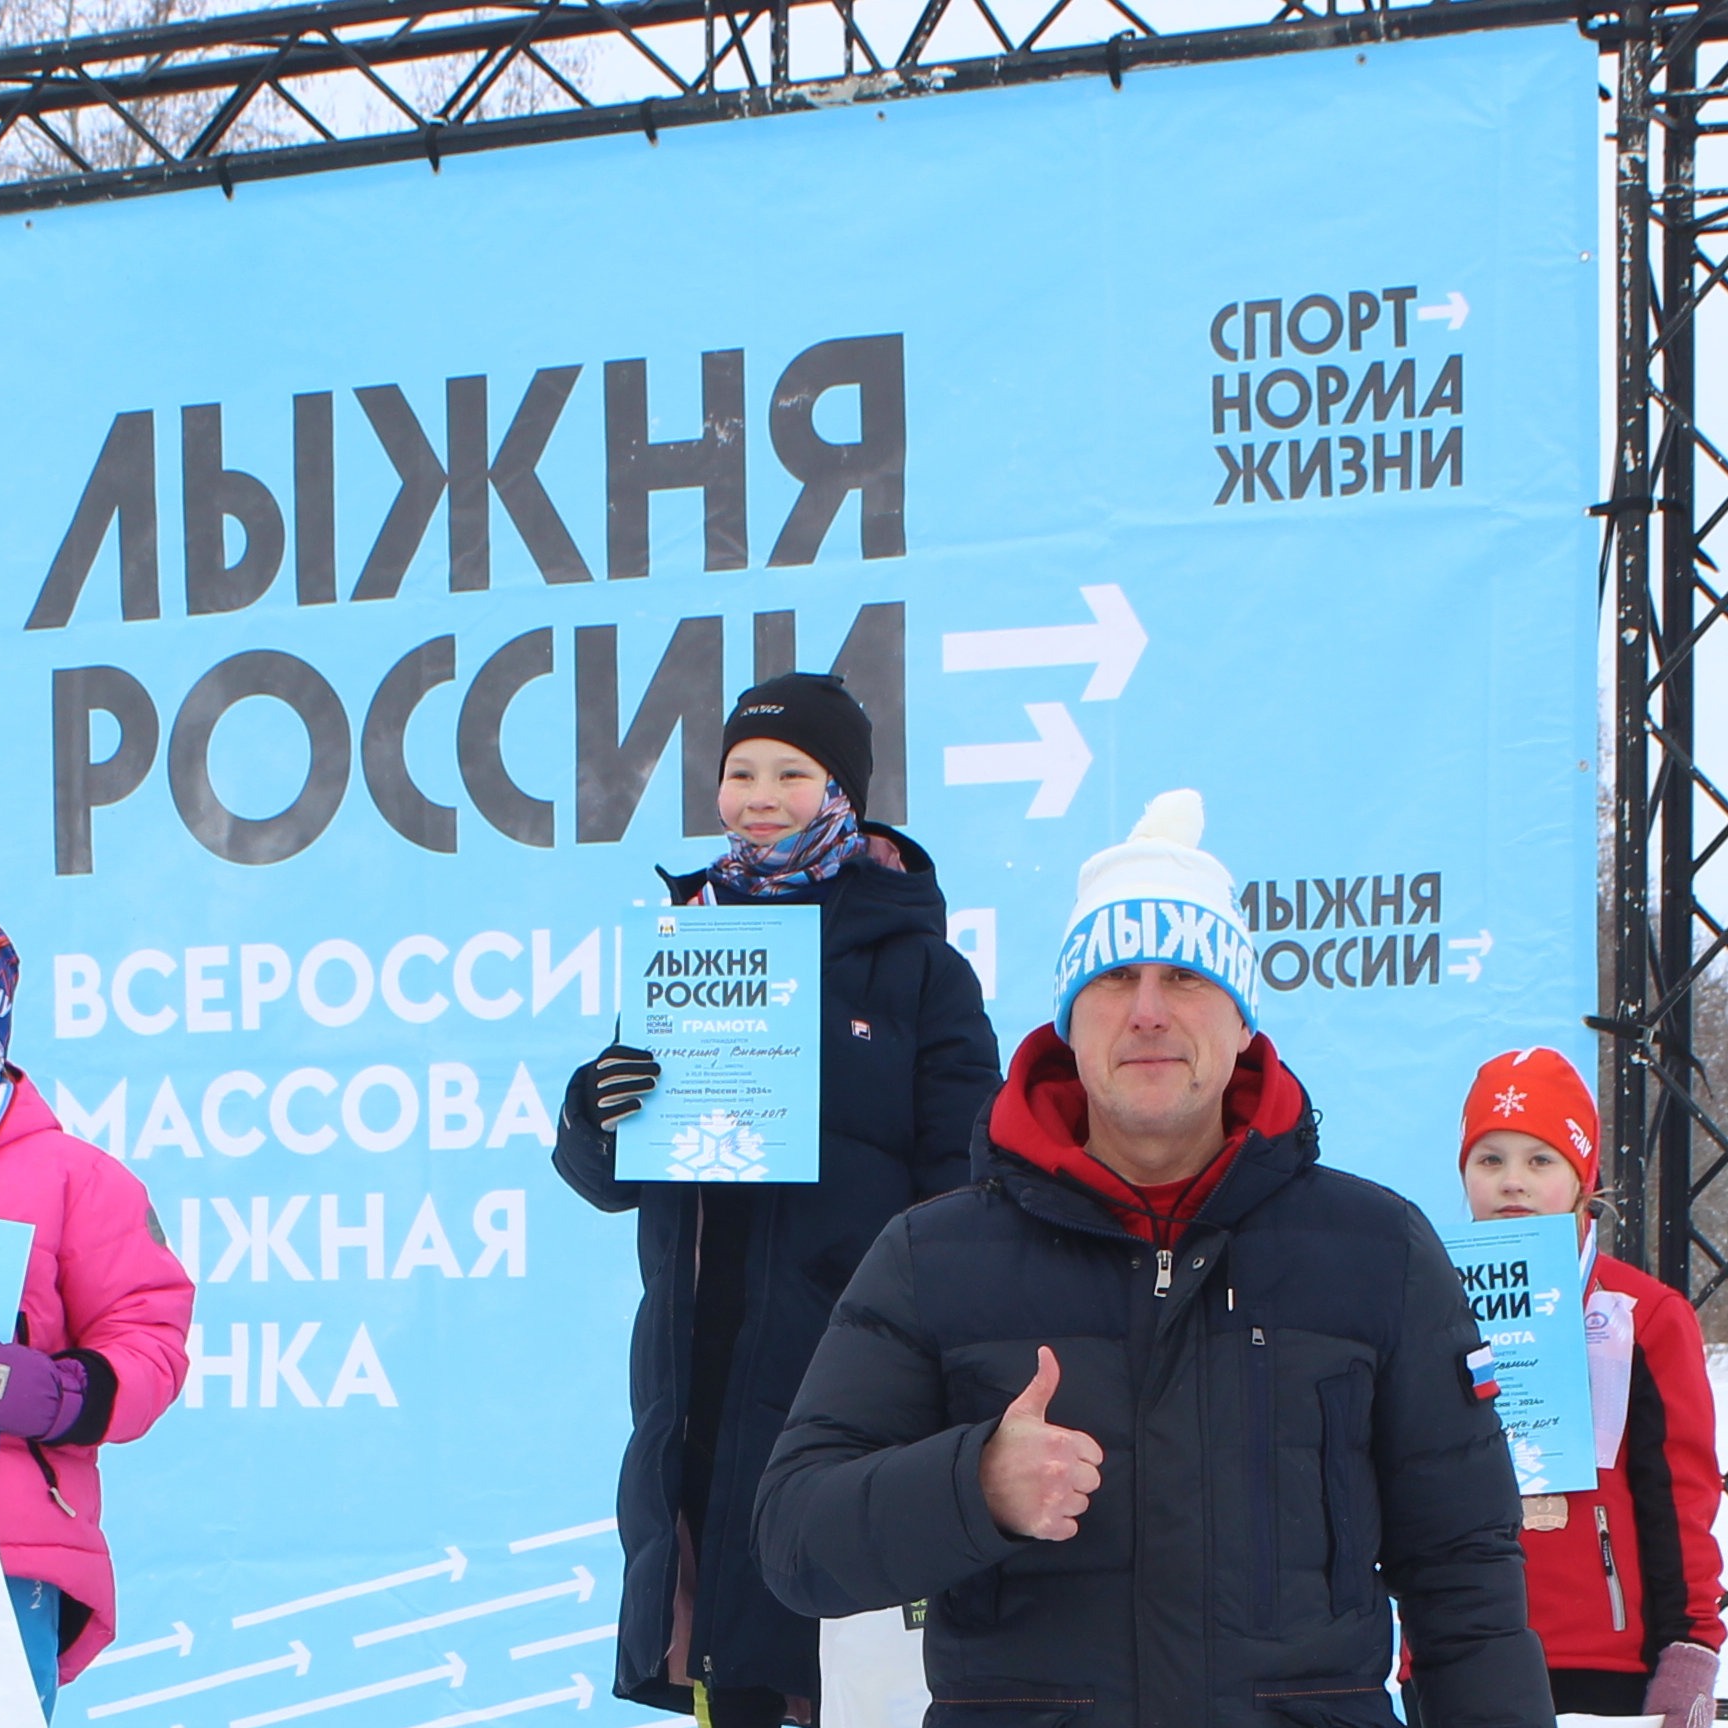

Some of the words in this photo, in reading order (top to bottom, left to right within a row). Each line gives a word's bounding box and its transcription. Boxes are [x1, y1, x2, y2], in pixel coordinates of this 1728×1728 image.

[1210, 285, 1418, 362] СПОРТ
[1212, 353, 1464, 435] НОРМА
[23, 333, 907, 630] ЛЫЖНЯ
[1213, 425, 1464, 506] ЖИЗНИ
[50, 601, 908, 876] РОССИИ
[643, 949, 767, 977] ЛЫЖНЯ
[646, 980, 767, 1008] РОССИИ
[1083, 901, 1255, 1014] ЛЫЖНЯ
[1254, 932, 1441, 991] ОССИИ
[681, 1018, 768, 1034] ГРАМОТА
[55, 1060, 556, 1161] МАССОВА
[184, 1321, 399, 1408] НКА
